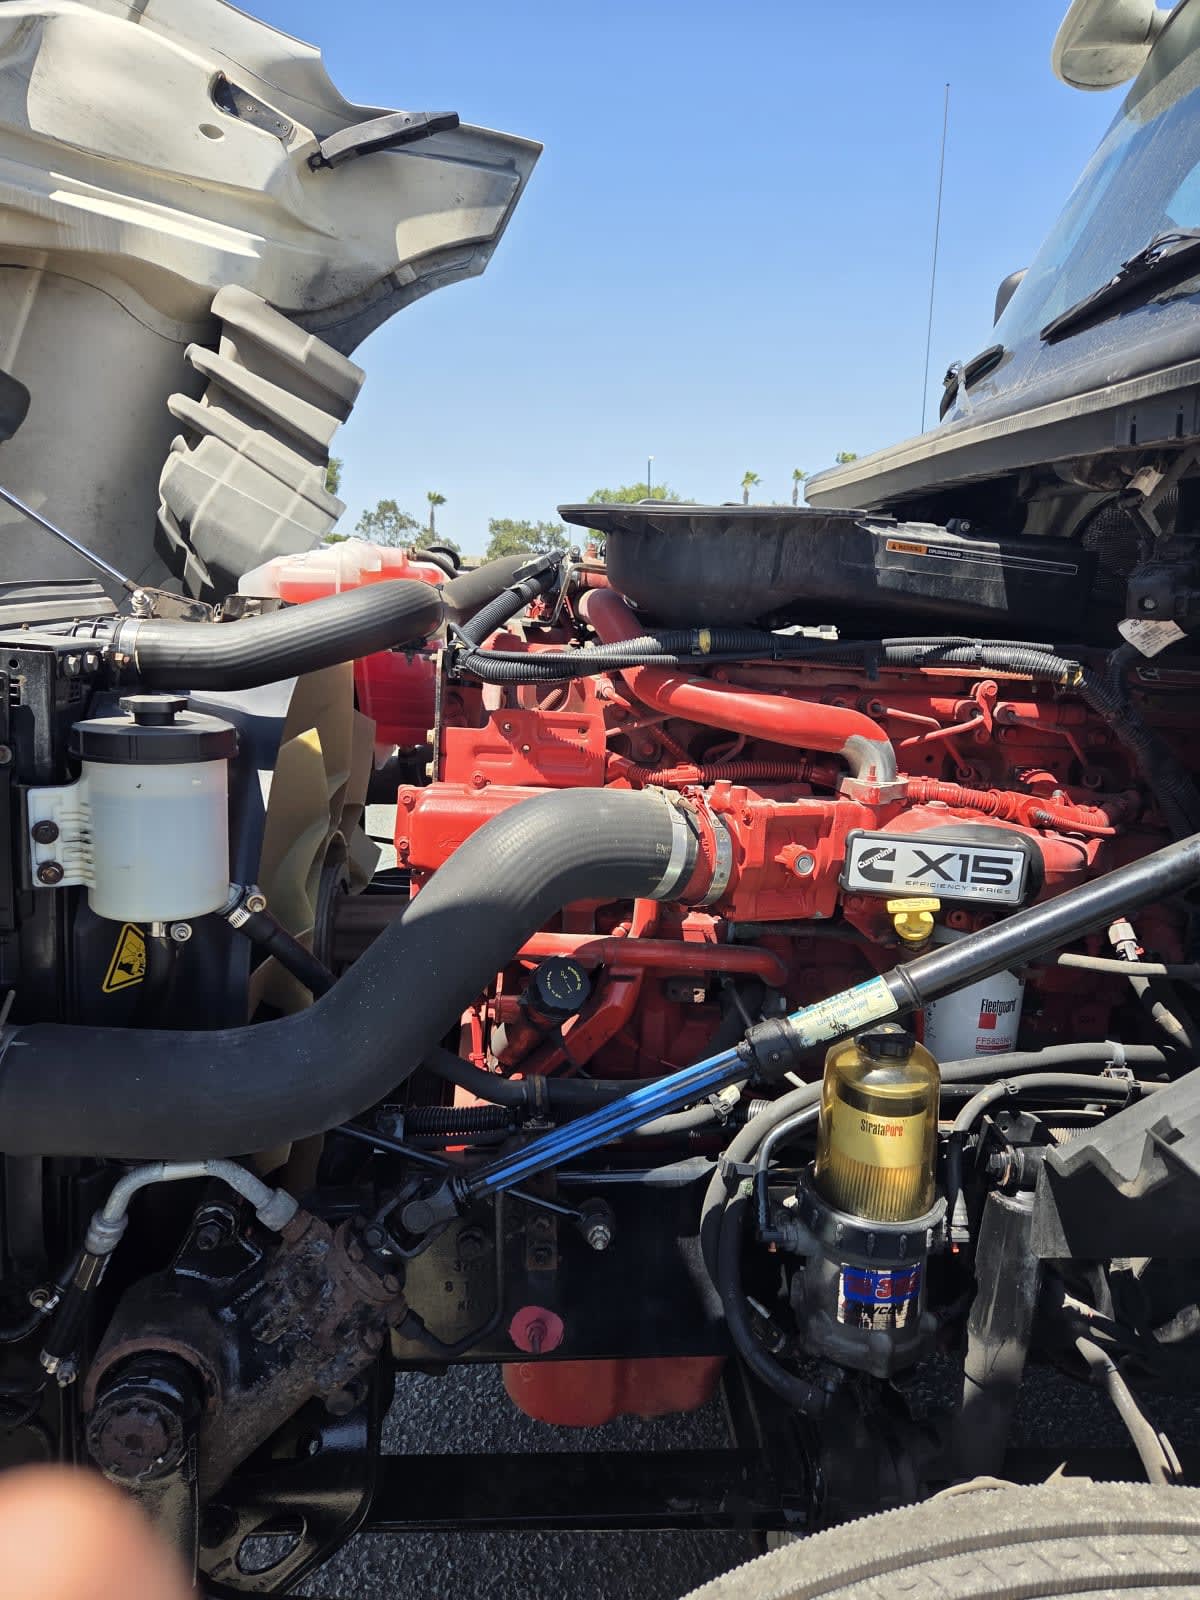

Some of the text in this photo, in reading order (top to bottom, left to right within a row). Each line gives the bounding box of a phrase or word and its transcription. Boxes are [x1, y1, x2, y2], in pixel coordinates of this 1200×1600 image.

[857, 847, 895, 869] Cummins
[906, 850, 1014, 886] X15
[904, 880, 1012, 895] EFFICIENCY SERIES
[981, 998, 1016, 1016] Fleetguard
[860, 1118, 904, 1137] StrataPore
